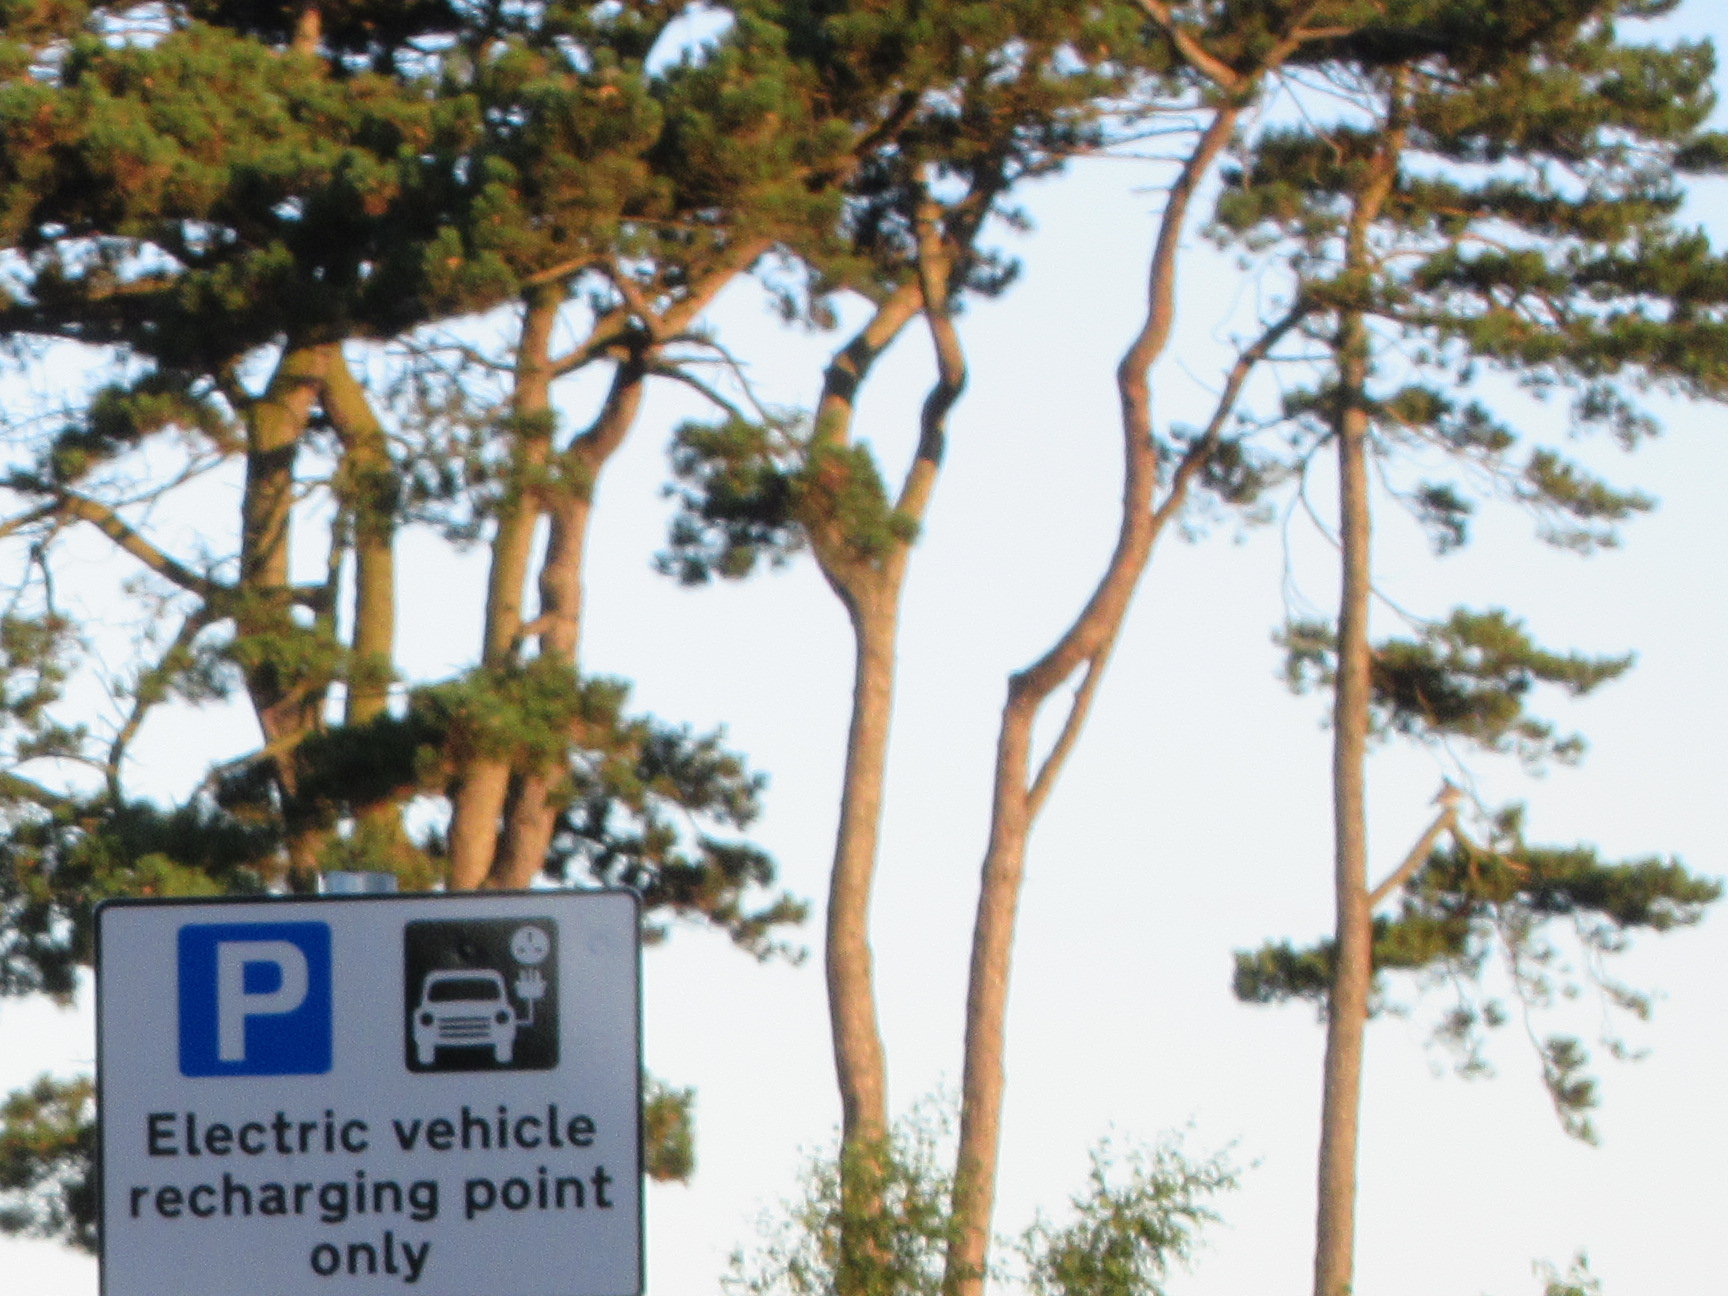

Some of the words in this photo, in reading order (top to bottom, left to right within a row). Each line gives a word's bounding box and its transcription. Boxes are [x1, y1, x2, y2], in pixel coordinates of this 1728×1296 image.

[217, 940, 309, 1062] P
[147, 1109, 368, 1157] Electric
[392, 1104, 596, 1152] vehicle
[130, 1170, 439, 1223] recharging
[464, 1167, 613, 1220] point
[310, 1231, 430, 1283] only
